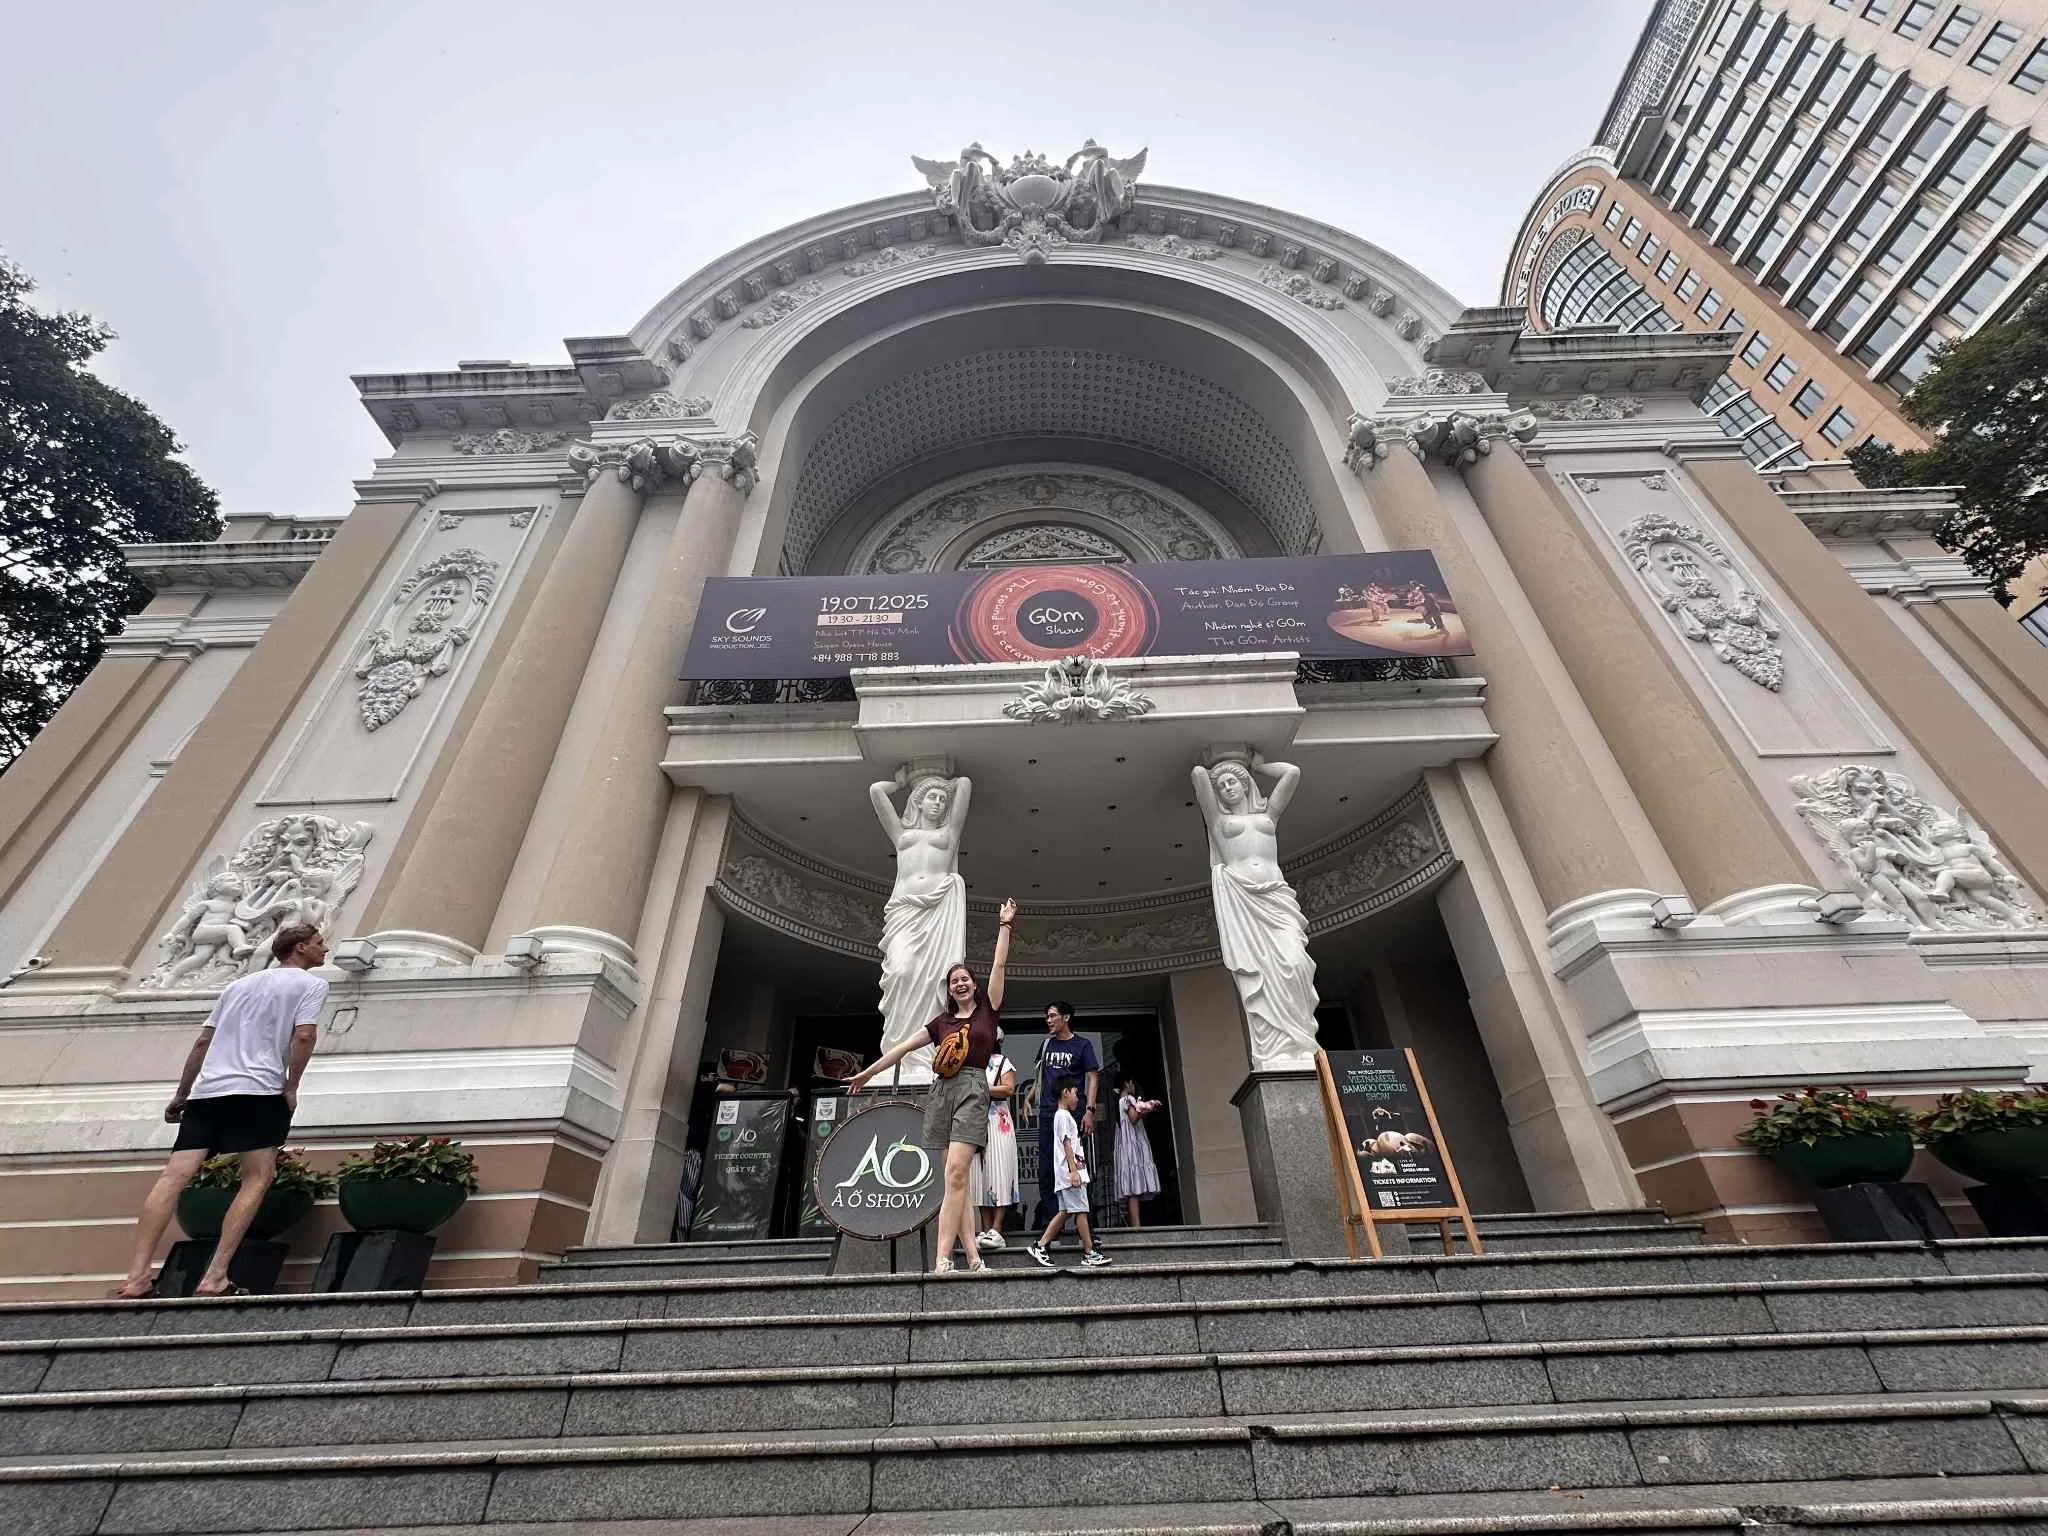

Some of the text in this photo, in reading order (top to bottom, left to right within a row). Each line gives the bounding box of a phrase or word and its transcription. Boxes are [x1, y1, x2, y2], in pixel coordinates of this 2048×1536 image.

[1552, 187, 1595, 221] HOTEL
[1006, 577, 1037, 593] The
[820, 594, 929, 612] 19.07.2025
[862, 614, 890, 624] 21:30
[992, 624, 1008, 636] of
[711, 634, 773, 643] SKY SOUNDS
[811, 654, 832, 664] +84
[834, 653, 853, 663] 988
[880, 651, 900, 662] 883
[1396, 1176, 1437, 1185] INFORMATION
[865, 1193, 925, 1209] SHOW
